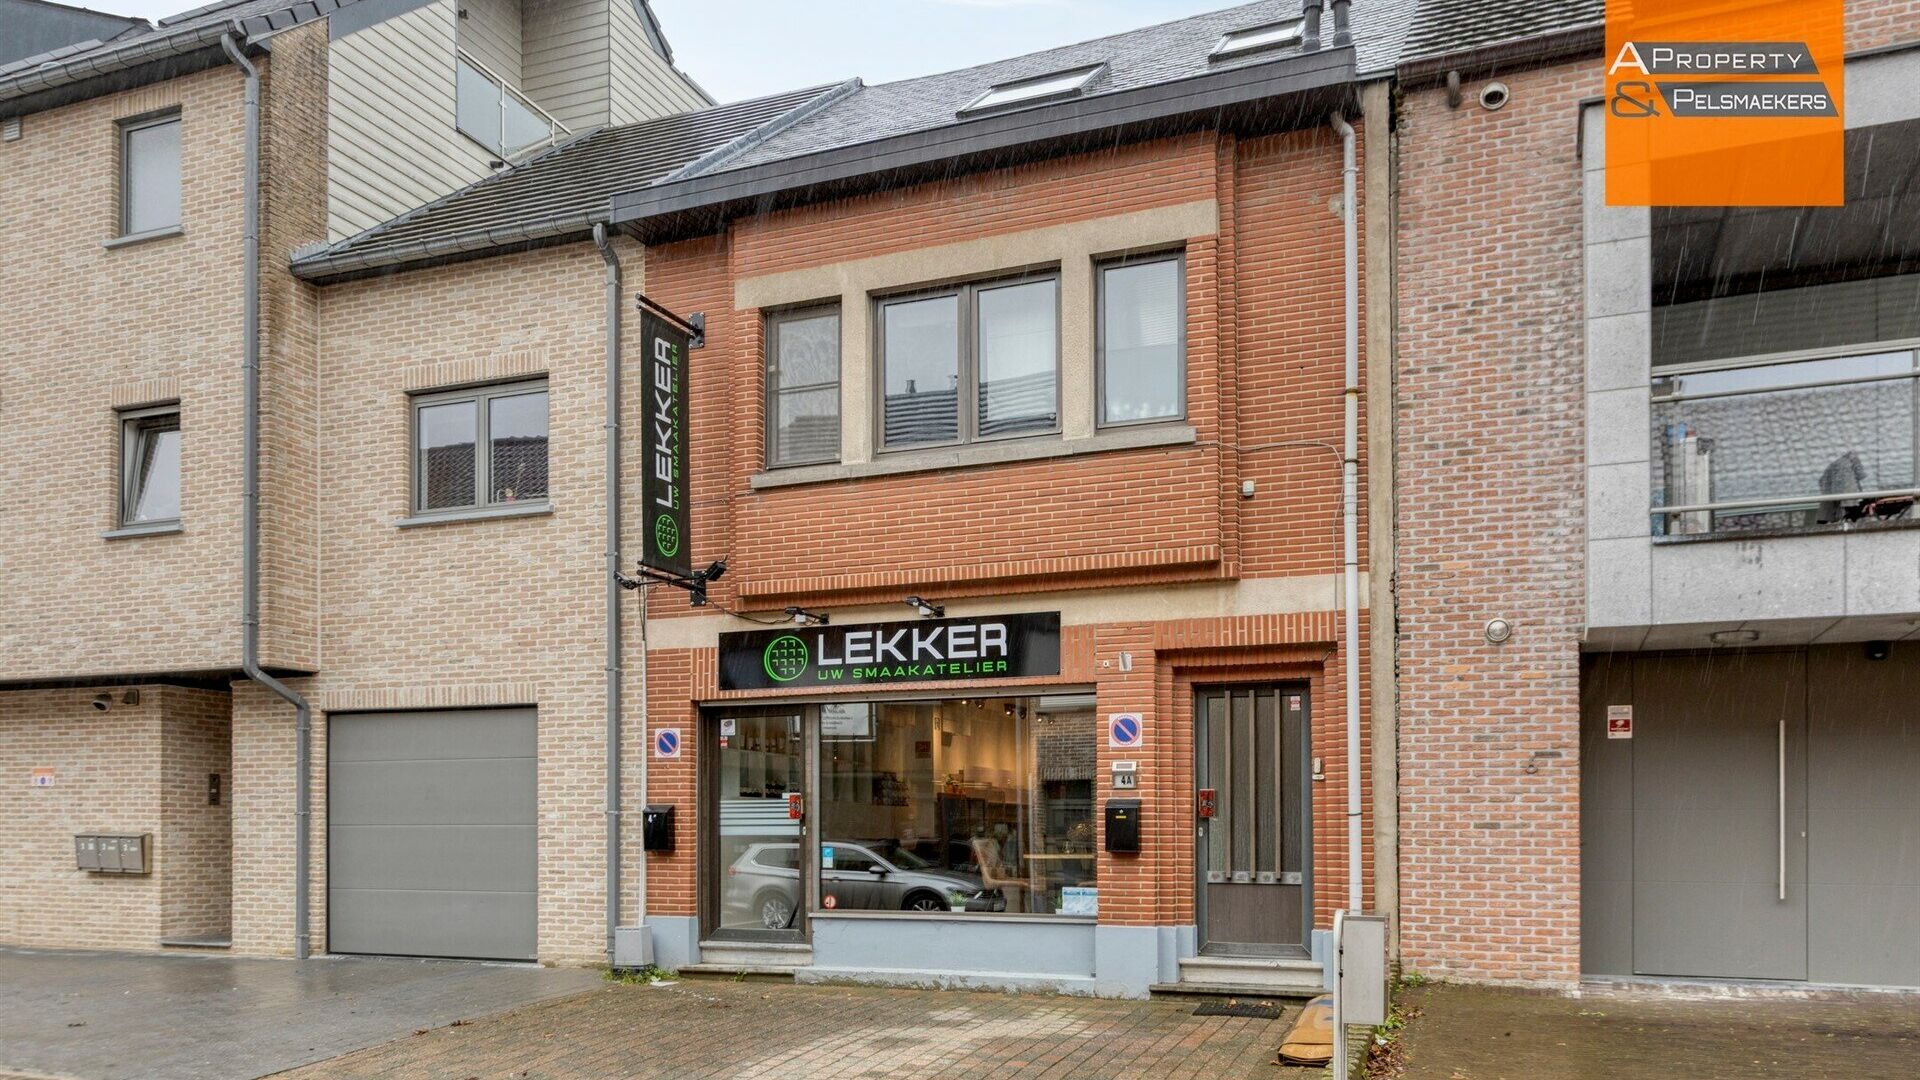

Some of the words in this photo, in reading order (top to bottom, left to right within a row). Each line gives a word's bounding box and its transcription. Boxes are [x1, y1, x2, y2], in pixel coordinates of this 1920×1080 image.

[655, 337, 672, 507] LEKKER
[673, 485, 680, 510] UW
[818, 623, 1007, 666] LEKKER
[818, 668, 843, 680] UW
[852, 660, 1007, 679] SMAAKATELIER
[1121, 775, 1132, 784] 4A
